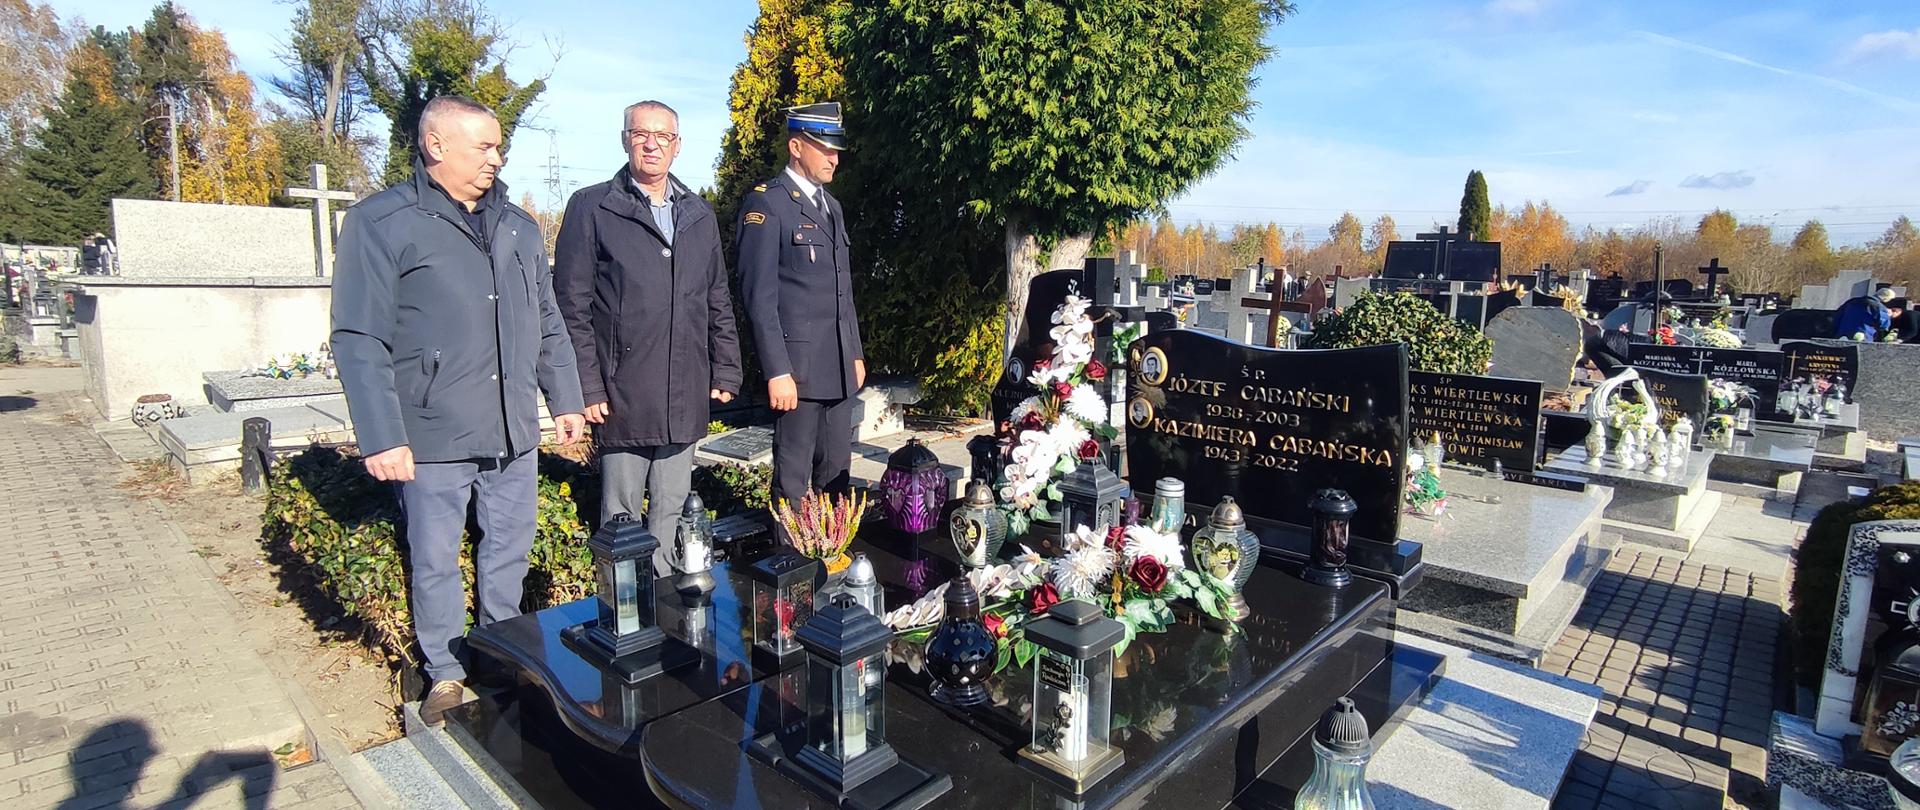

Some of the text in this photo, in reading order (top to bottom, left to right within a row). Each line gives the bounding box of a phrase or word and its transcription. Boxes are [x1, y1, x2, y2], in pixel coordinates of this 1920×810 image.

[1167, 372, 1350, 413] JÓZEF CABAŃSKI
[1433, 385, 1528, 406] WIERTLEWSKI
[1423, 406, 1522, 427] WIERTLEWSKA
[1154, 417, 1392, 468] KAZIMIERA CABAŃSKA
[1412, 427, 1460, 442] JADIGA
